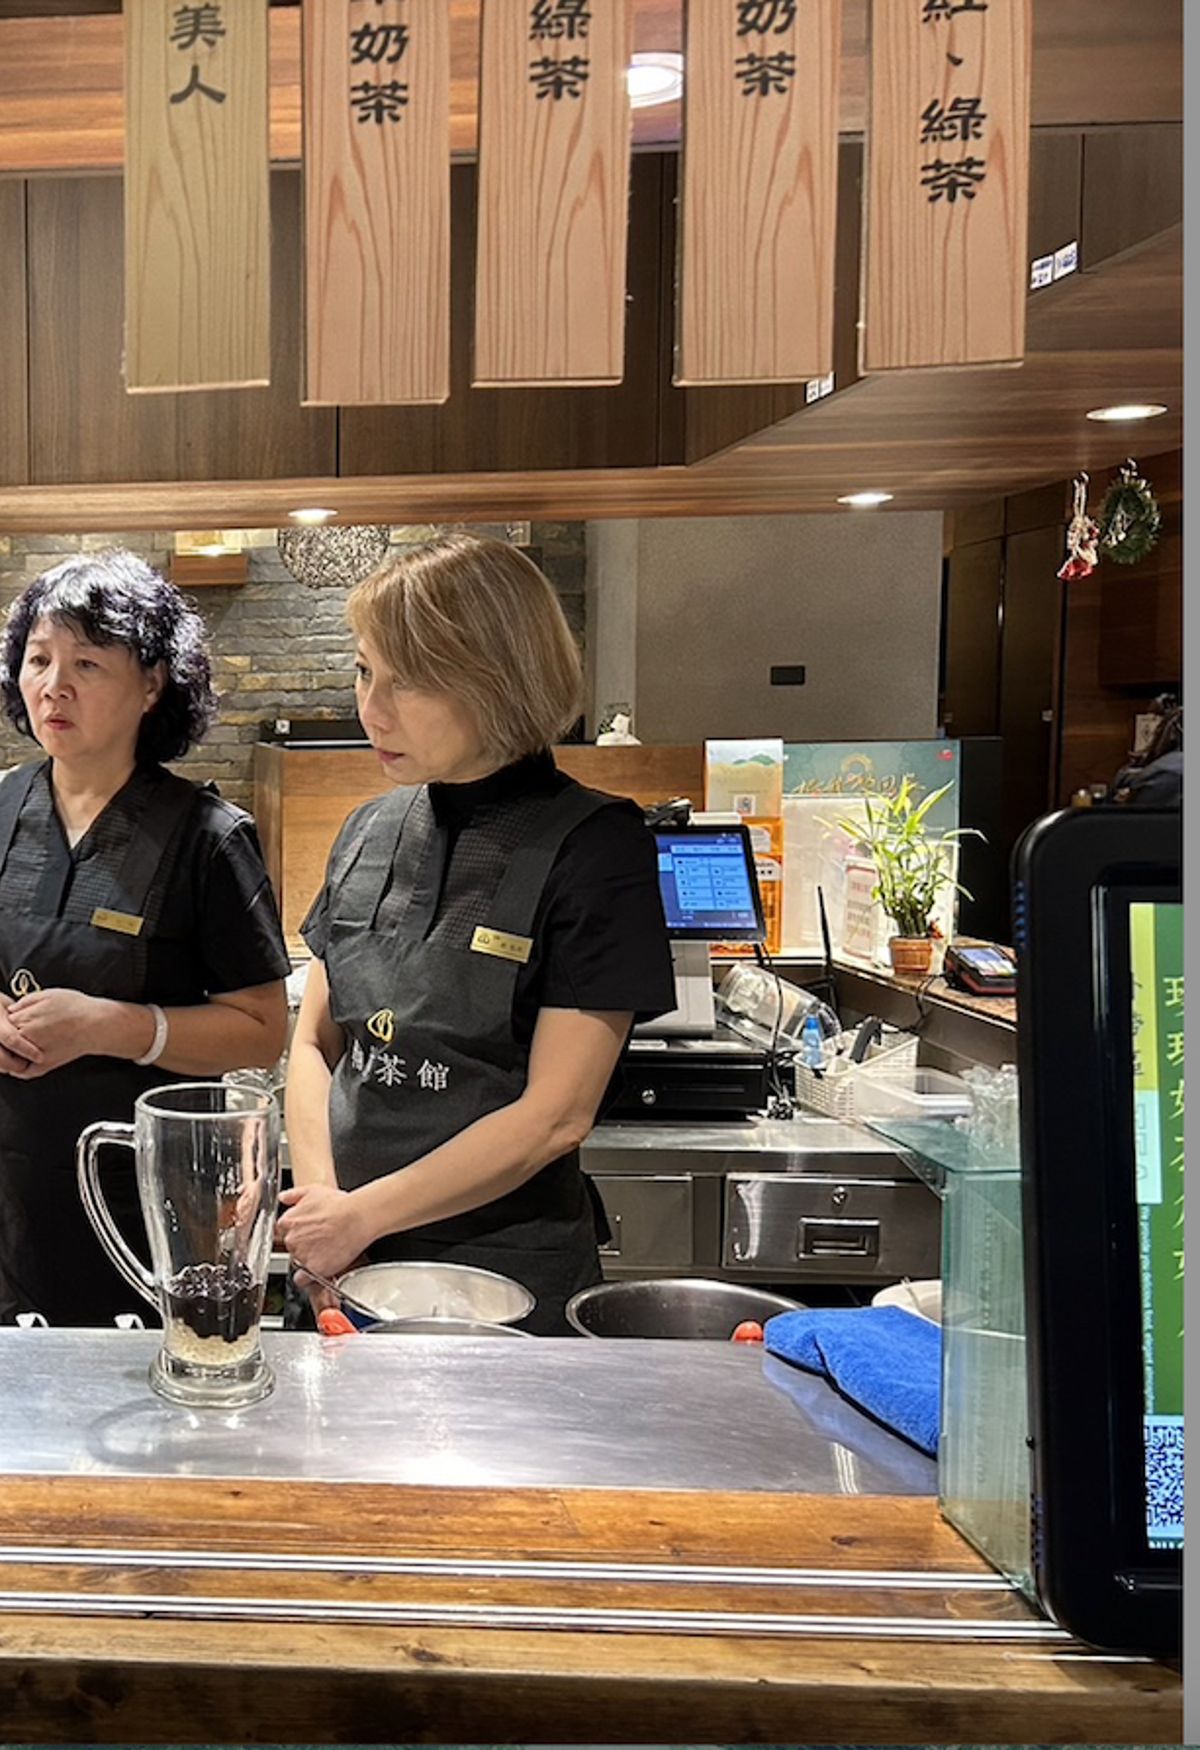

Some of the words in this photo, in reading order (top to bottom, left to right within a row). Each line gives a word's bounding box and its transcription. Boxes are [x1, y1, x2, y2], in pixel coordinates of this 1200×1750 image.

[168, 3, 227, 105] 美人
[349, 0, 409, 125] 奶茶
[528, 0, 592, 100] 綠茶
[735, 0, 797, 97] 奶茶
